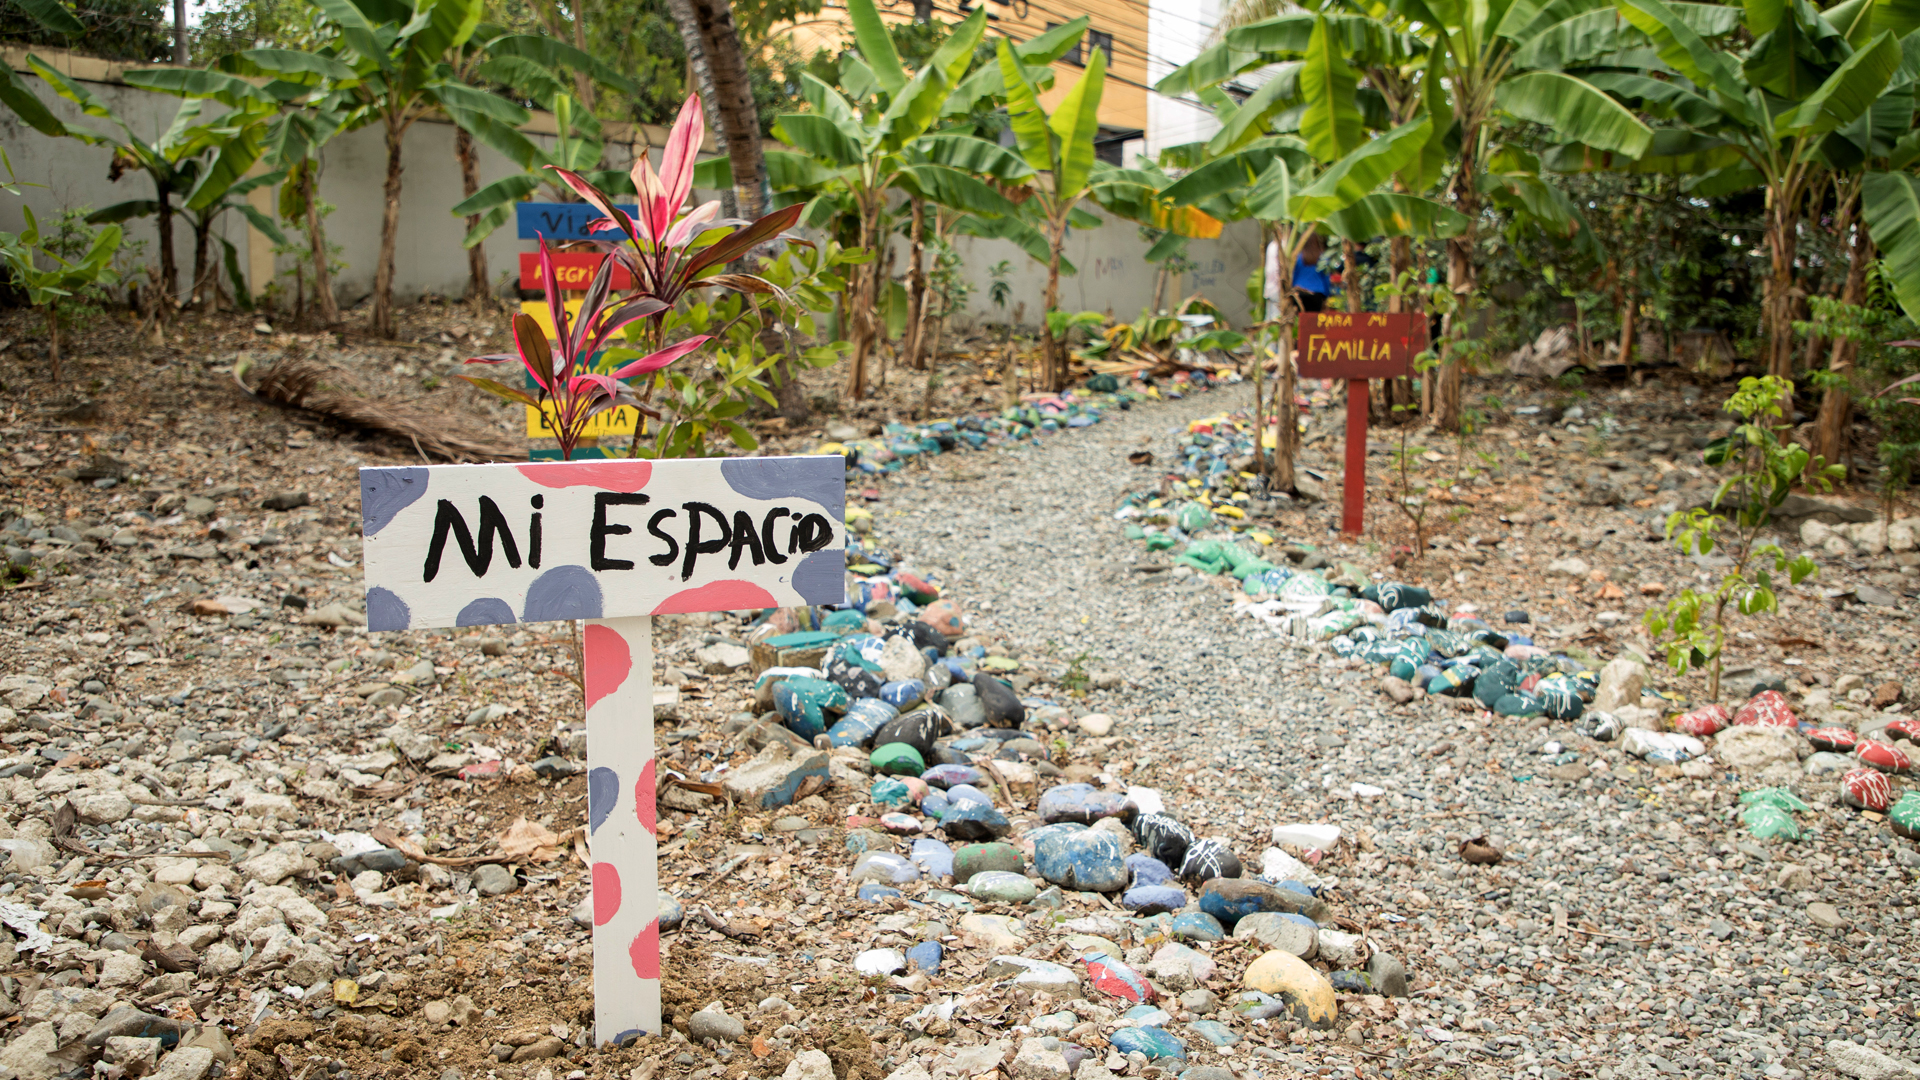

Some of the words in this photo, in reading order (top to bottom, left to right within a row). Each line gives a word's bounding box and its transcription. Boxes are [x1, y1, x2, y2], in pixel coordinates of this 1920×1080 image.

[541, 209, 610, 236] Vid
[1317, 313, 1352, 327] PARA
[423, 493, 544, 583] Mi
